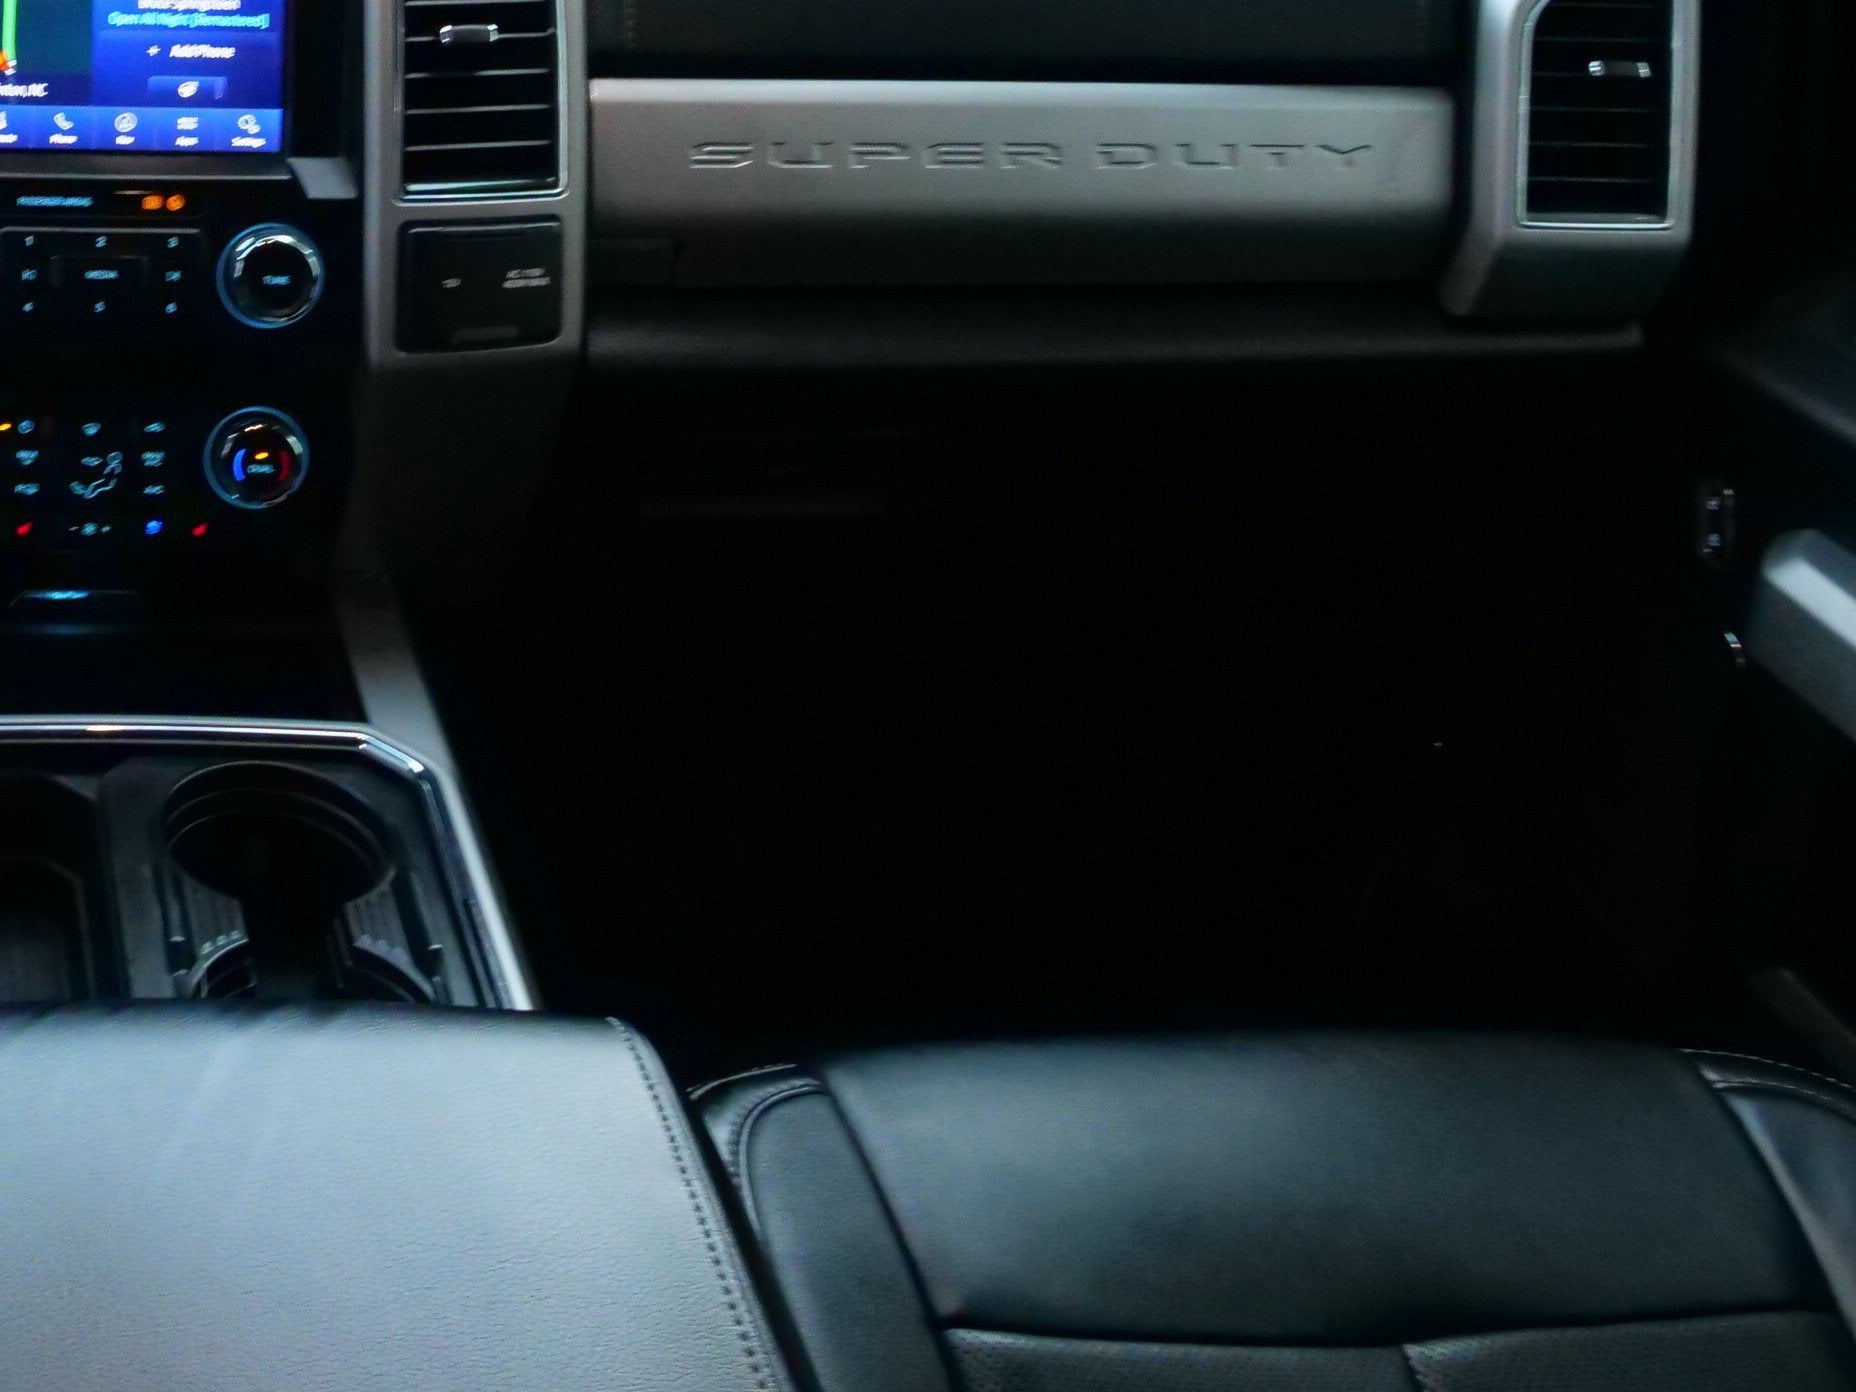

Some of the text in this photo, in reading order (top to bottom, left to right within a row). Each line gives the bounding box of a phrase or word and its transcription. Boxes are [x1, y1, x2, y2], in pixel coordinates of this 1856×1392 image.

[689, 140, 1373, 170] SUPER DUTY
[95, 235, 107, 248] 2
